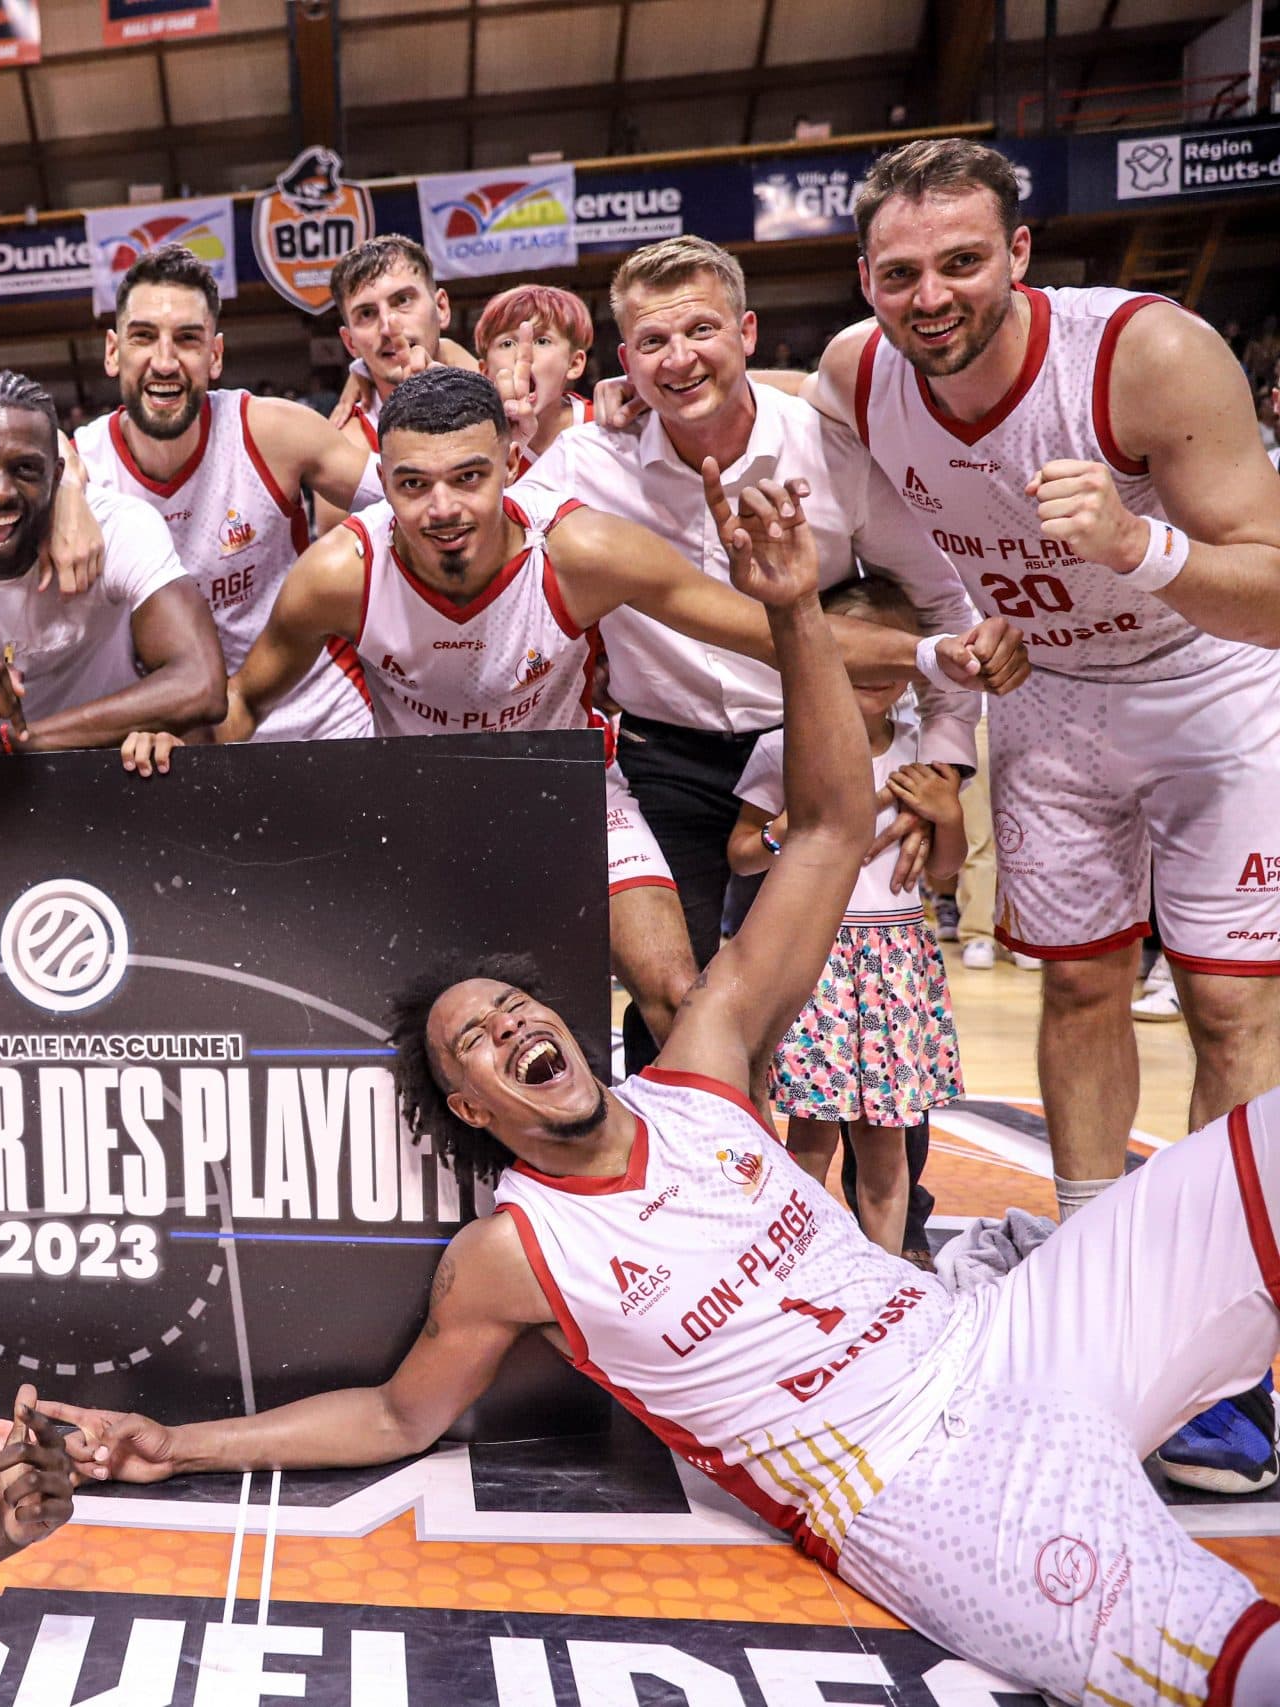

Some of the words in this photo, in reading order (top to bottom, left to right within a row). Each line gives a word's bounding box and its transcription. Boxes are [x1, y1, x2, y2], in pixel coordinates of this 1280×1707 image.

[1184, 139, 1252, 161] Région
[576, 188, 682, 223] erque
[275, 219, 354, 257] BCM
[949, 459, 987, 472] CRAFT
[1061, 557, 1087, 567] BAS
[980, 573, 1074, 618] 20
[433, 641, 473, 650] CRAFT
[1227, 931, 1277, 941] CRAFT
[62, 1034, 227, 1060] MASCULINE
[228, 1034, 243, 1060] 1
[38, 1066, 167, 1217] DES
[639, 1189, 671, 1222] CRAFT
[661, 1188, 814, 1358] LOON-PLAGE
[774, 1253, 798, 1282] ASLP
[620, 1264, 672, 1317] AREAS
[637, 1284, 672, 1317] assurances
[778, 1296, 847, 1336] 1
